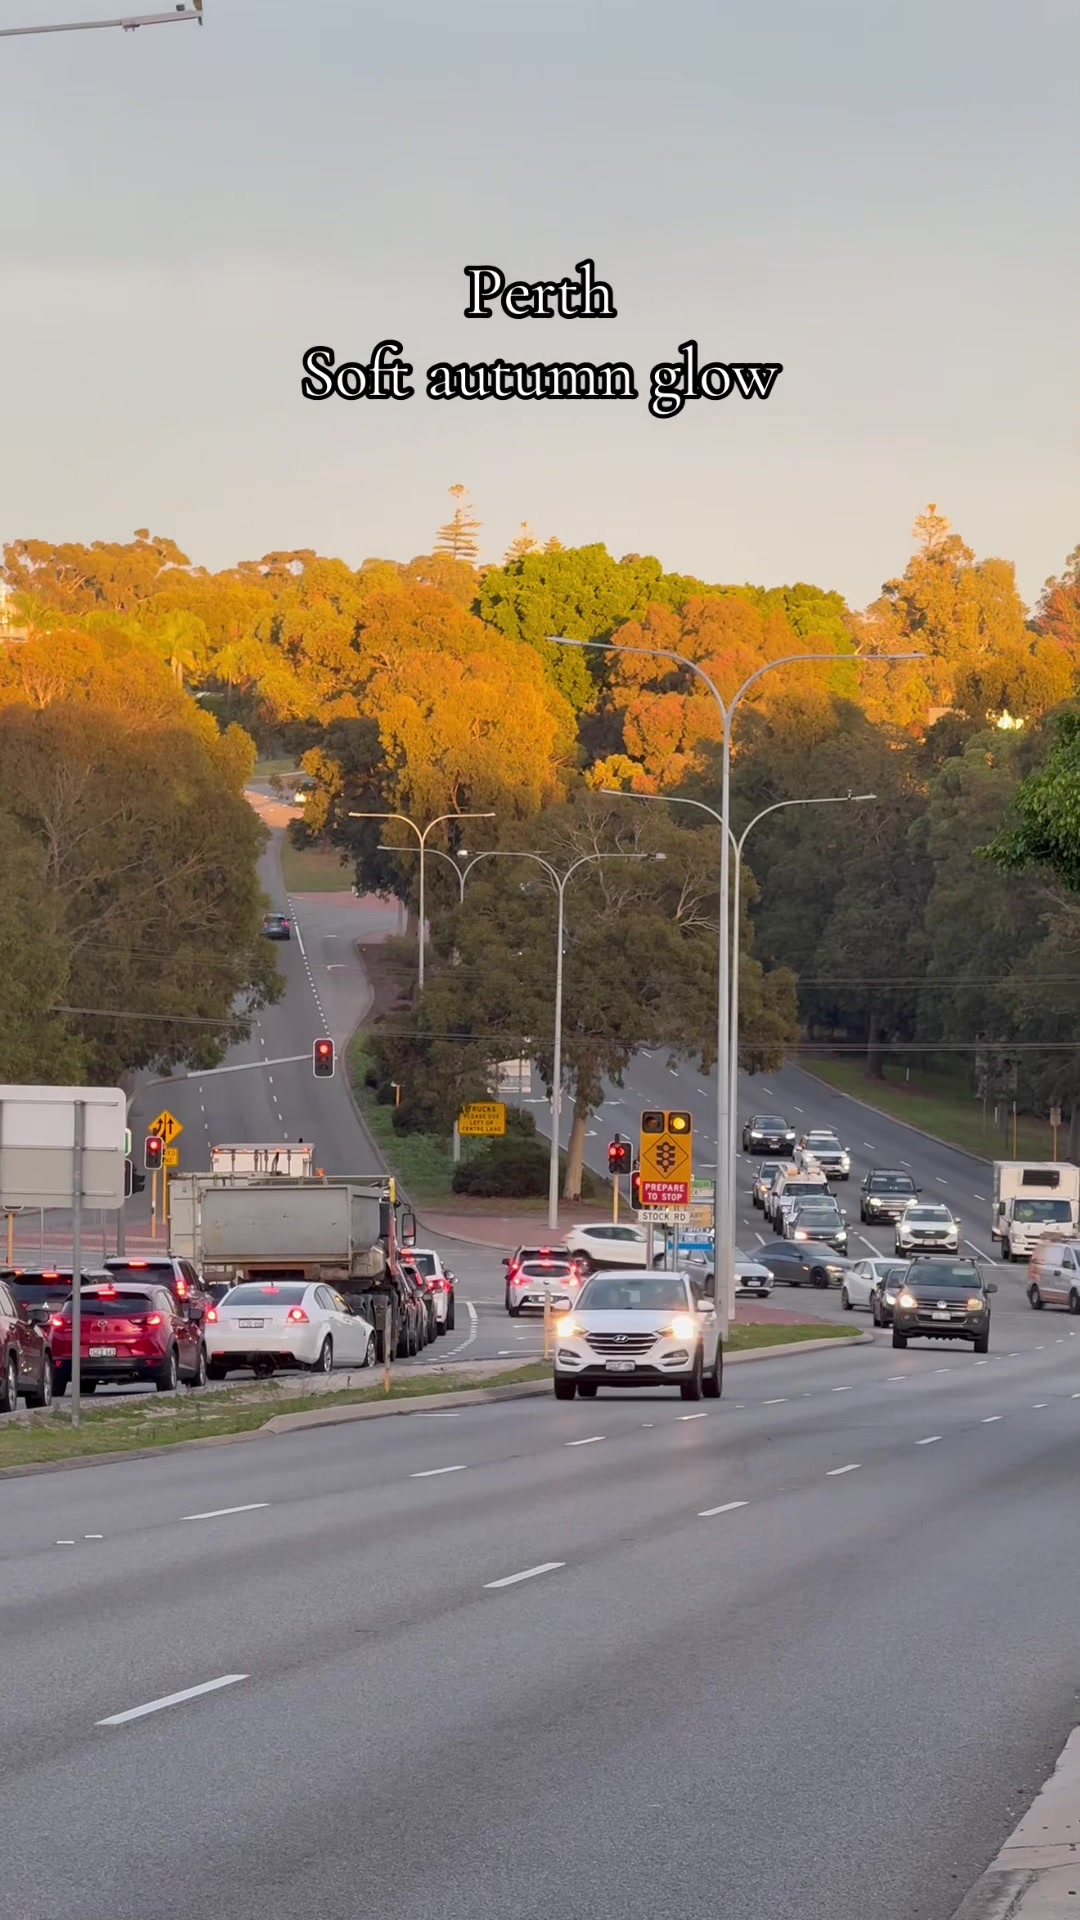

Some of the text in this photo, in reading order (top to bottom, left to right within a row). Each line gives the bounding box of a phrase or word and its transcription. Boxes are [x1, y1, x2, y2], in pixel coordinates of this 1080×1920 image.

[644, 1183, 685, 1192] PREPARE
[647, 1192, 683, 1201] TO STOP
[642, 1212, 686, 1221] STOCK RD
